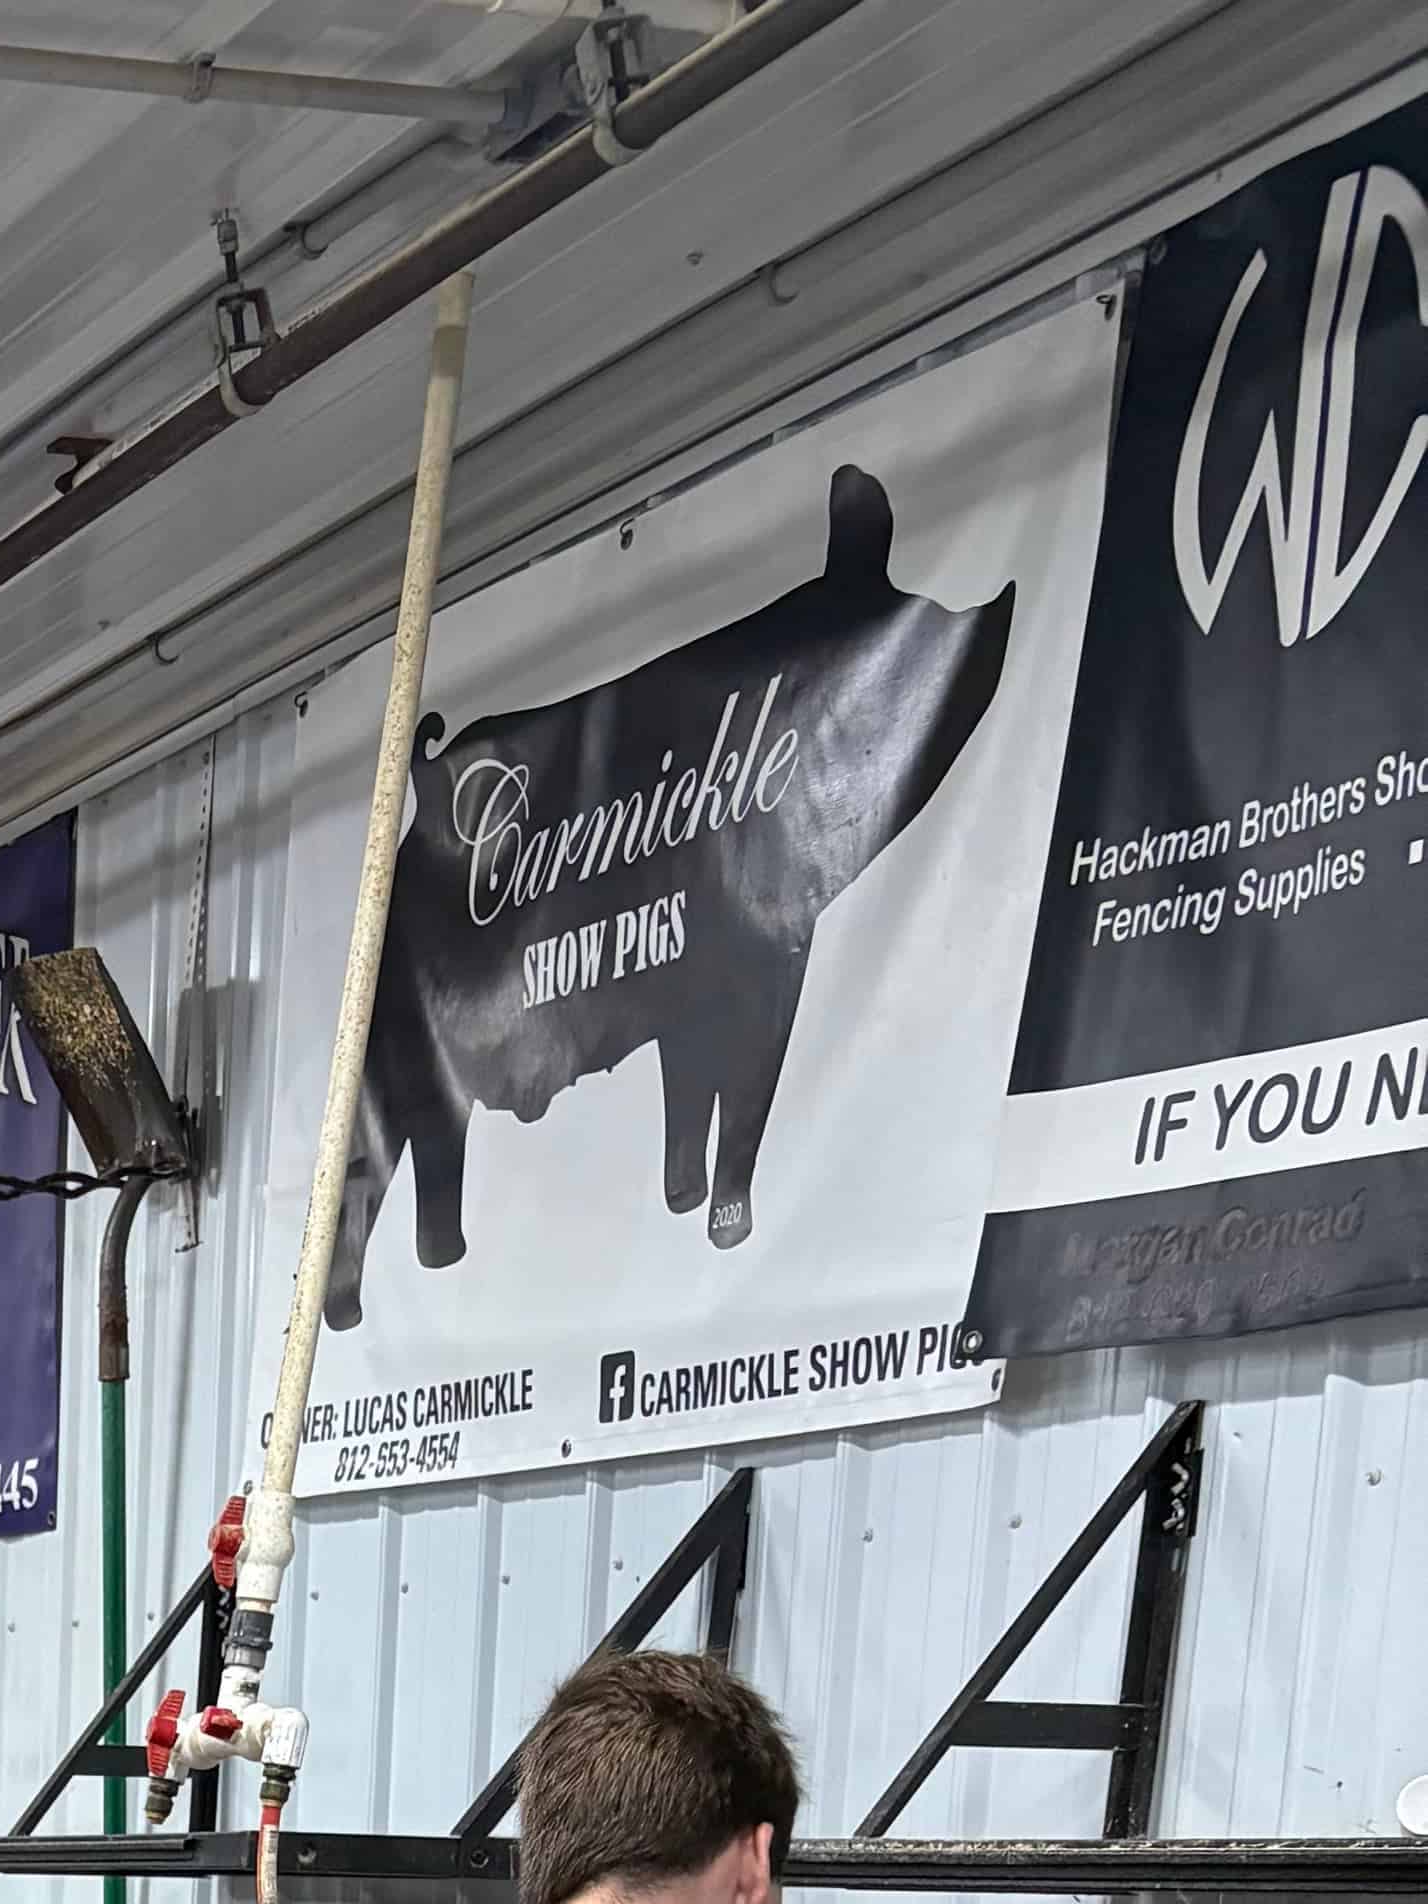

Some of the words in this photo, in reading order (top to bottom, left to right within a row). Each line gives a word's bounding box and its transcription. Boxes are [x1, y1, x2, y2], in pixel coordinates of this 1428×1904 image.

[453, 672, 799, 926] Carmickle
[1069, 817, 1231, 886] Hackman
[1238, 775, 1366, 848] Brothers
[522, 919, 607, 1009] SHOW
[612, 889, 687, 980] PIGS
[1092, 884, 1226, 947] Fencing
[1234, 845, 1366, 919] Supplies
[1134, 1089, 1197, 1166] IF
[1213, 1060, 1353, 1151] YOU
[342, 1390, 408, 1438] LUCAS
[412, 1368, 534, 1428] CARMICKLE
[640, 1348, 800, 1418] CARMICKLE
[808, 1330, 911, 1392] SHOW
